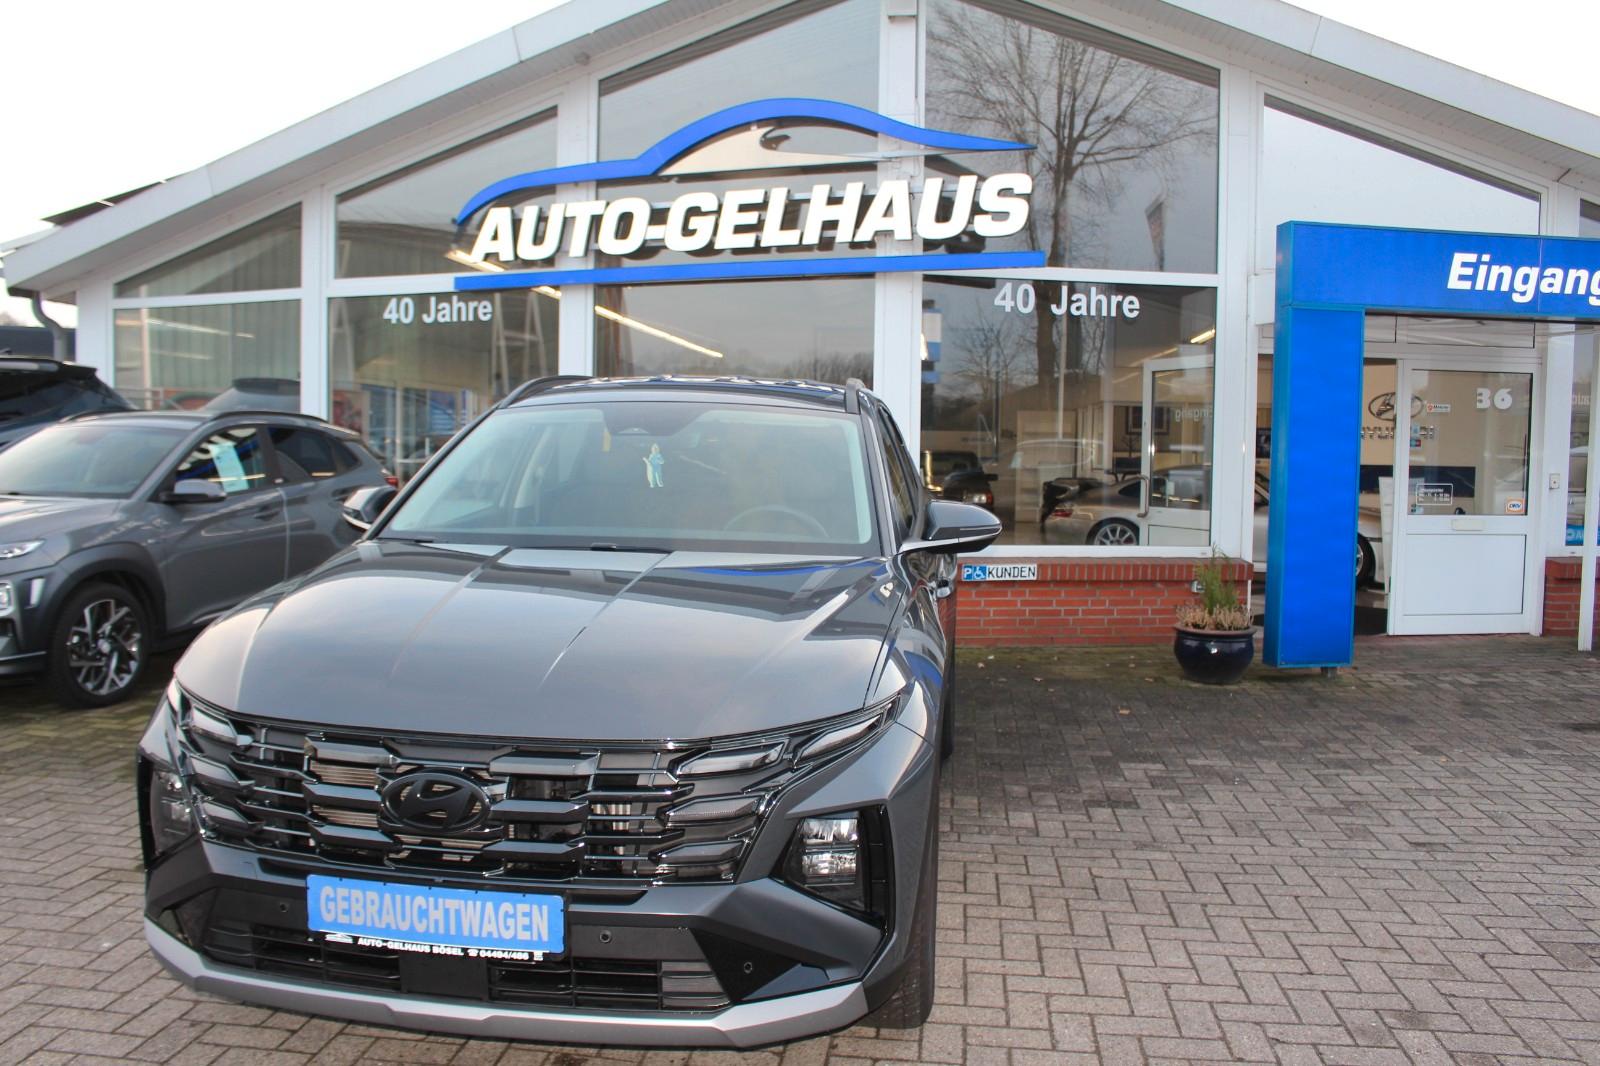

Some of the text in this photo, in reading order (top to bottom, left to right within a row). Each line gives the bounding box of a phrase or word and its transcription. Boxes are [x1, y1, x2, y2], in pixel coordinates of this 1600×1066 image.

[469, 171, 1034, 263] AUTO-GELHAUS
[382, 295, 493, 324] 40 Jahre
[993, 282, 1141, 319] 40 Jahre
[1476, 387, 1513, 410] 36
[988, 566, 1036, 579] KUNDEN
[319, 885, 549, 943] GEBRAUCHTWAGEN
[357, 937, 431, 954] AUTO-GELHAUS
[432, 944, 465, 957] BÖSEL
